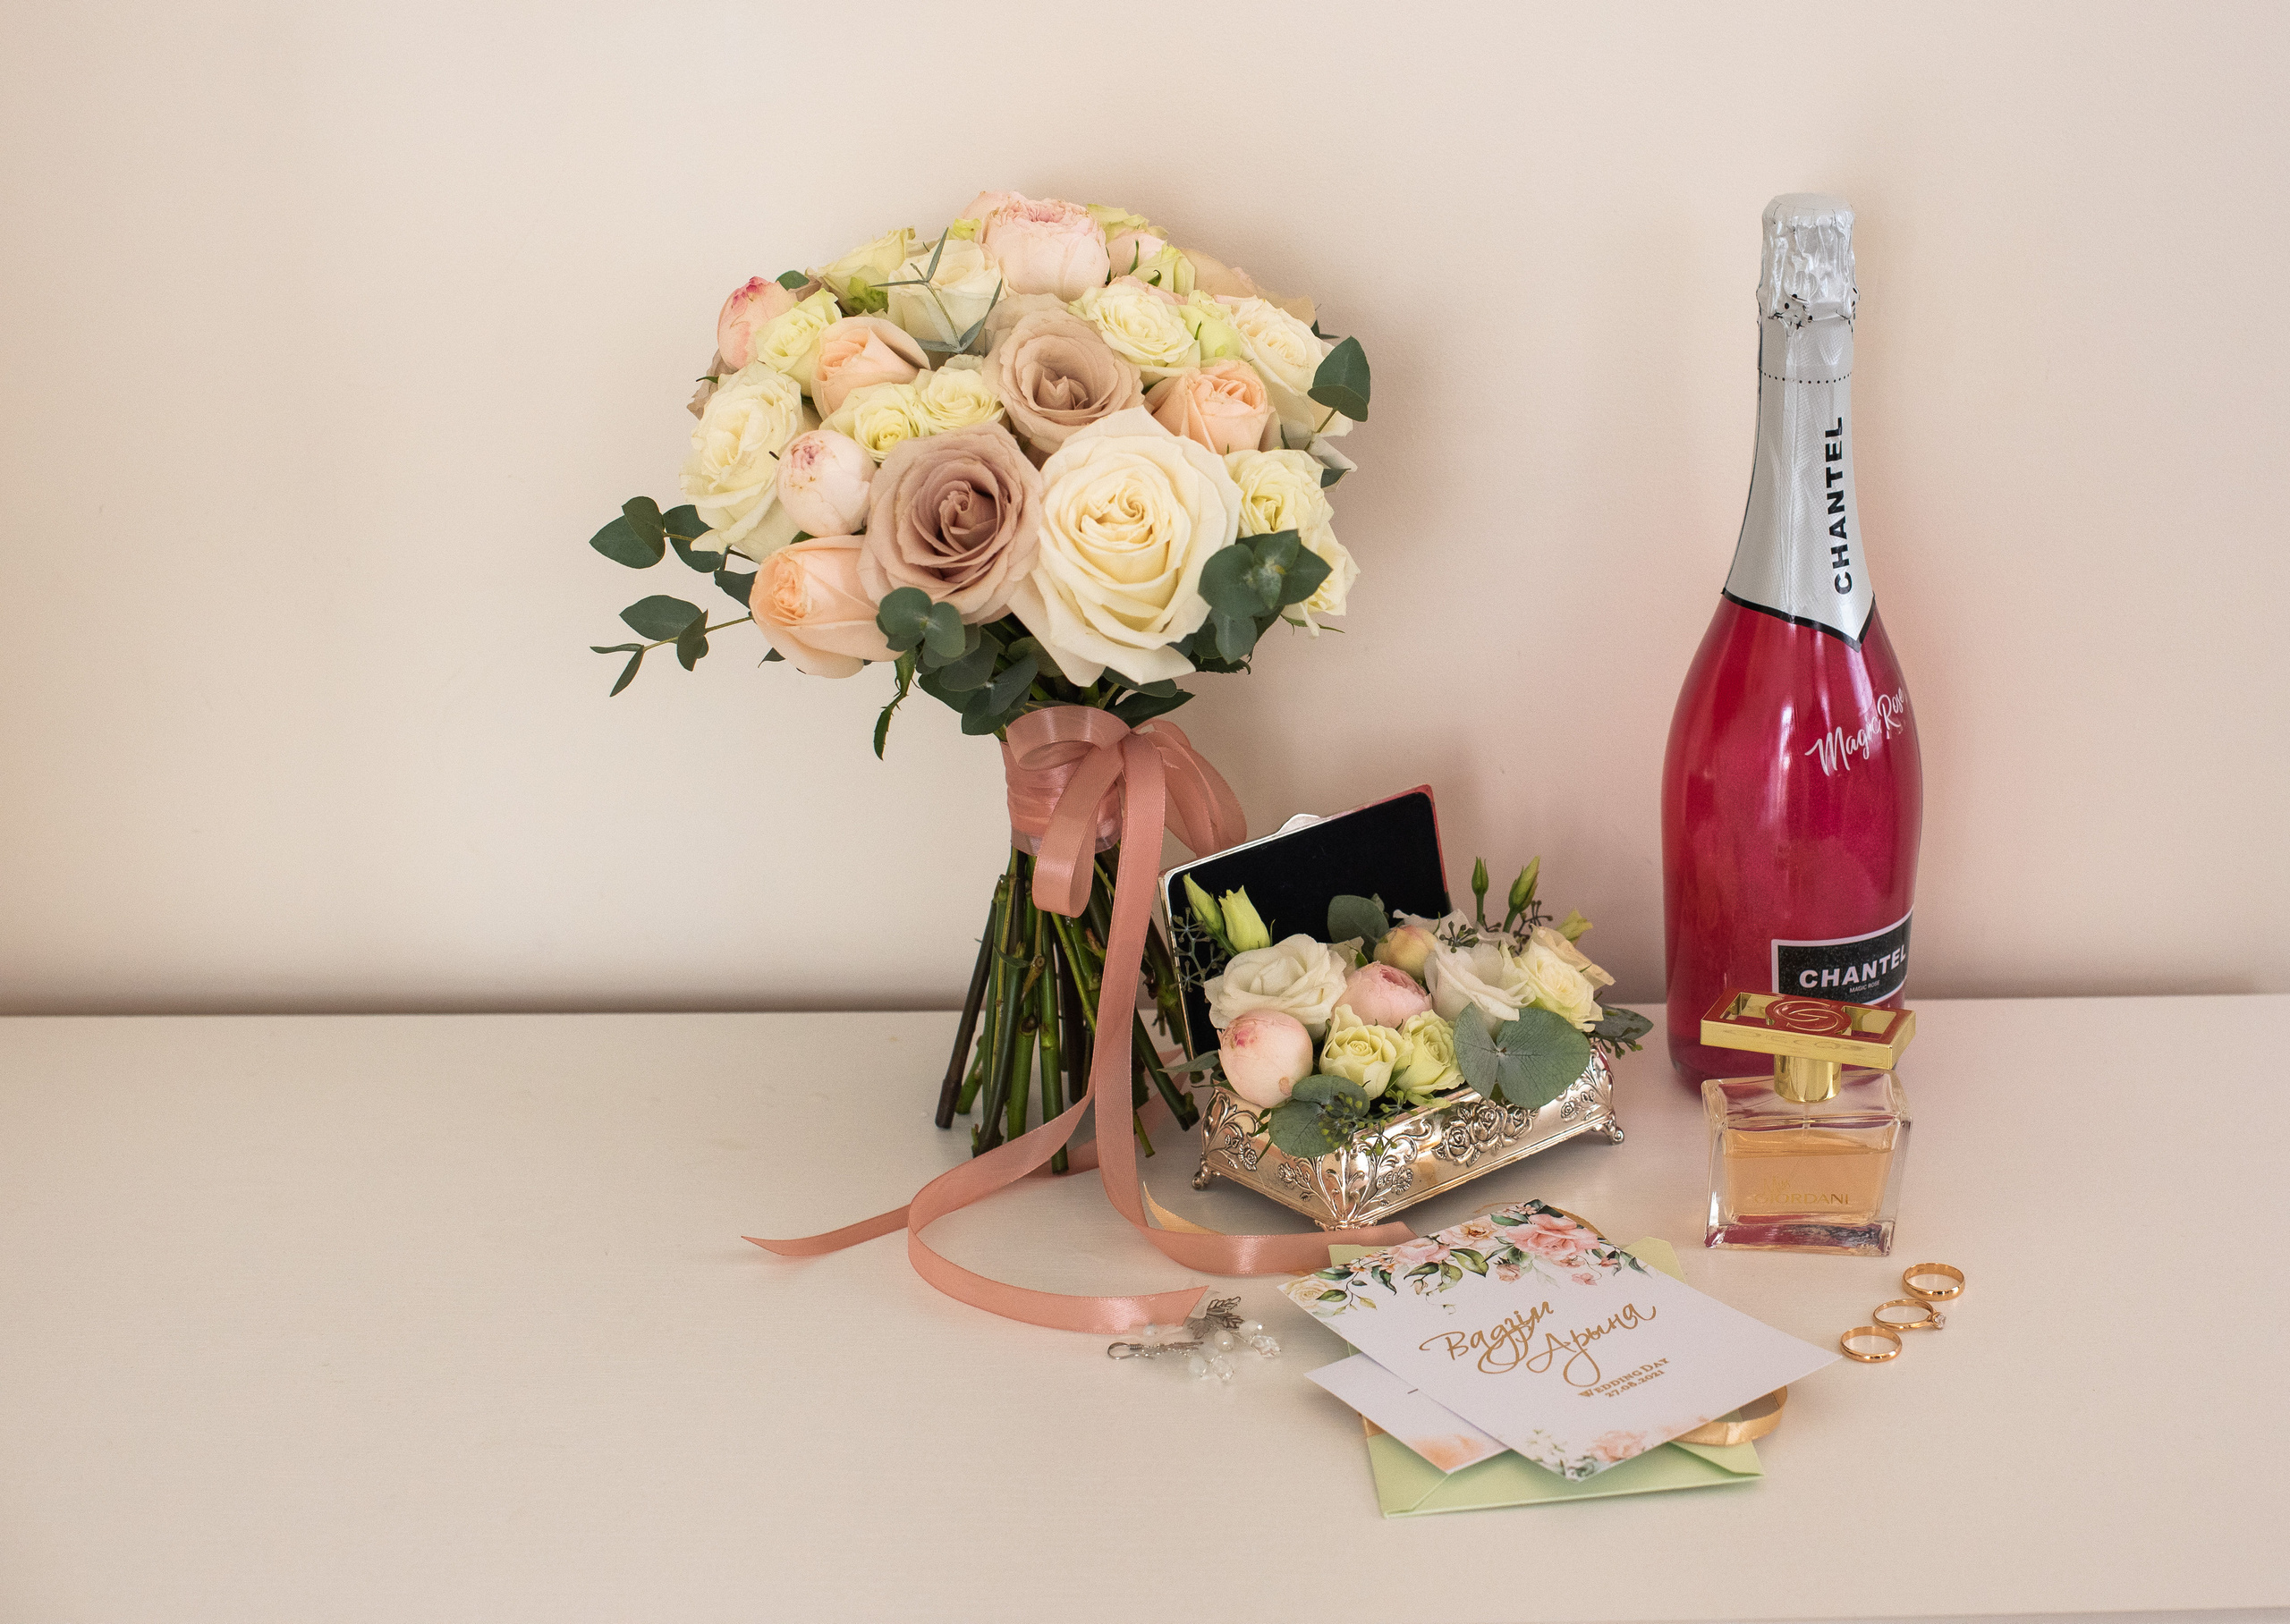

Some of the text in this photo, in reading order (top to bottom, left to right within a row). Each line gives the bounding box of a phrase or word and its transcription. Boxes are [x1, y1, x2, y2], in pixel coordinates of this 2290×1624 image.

[1824, 417, 1853, 595] CHANTEL
[1804, 687, 1904, 776] Magic Rose
[1799, 944, 1906, 988] CHANTEL
[1849, 984, 1867, 993] MAGIC
[1754, 1193, 1849, 1205] GIORDANI
